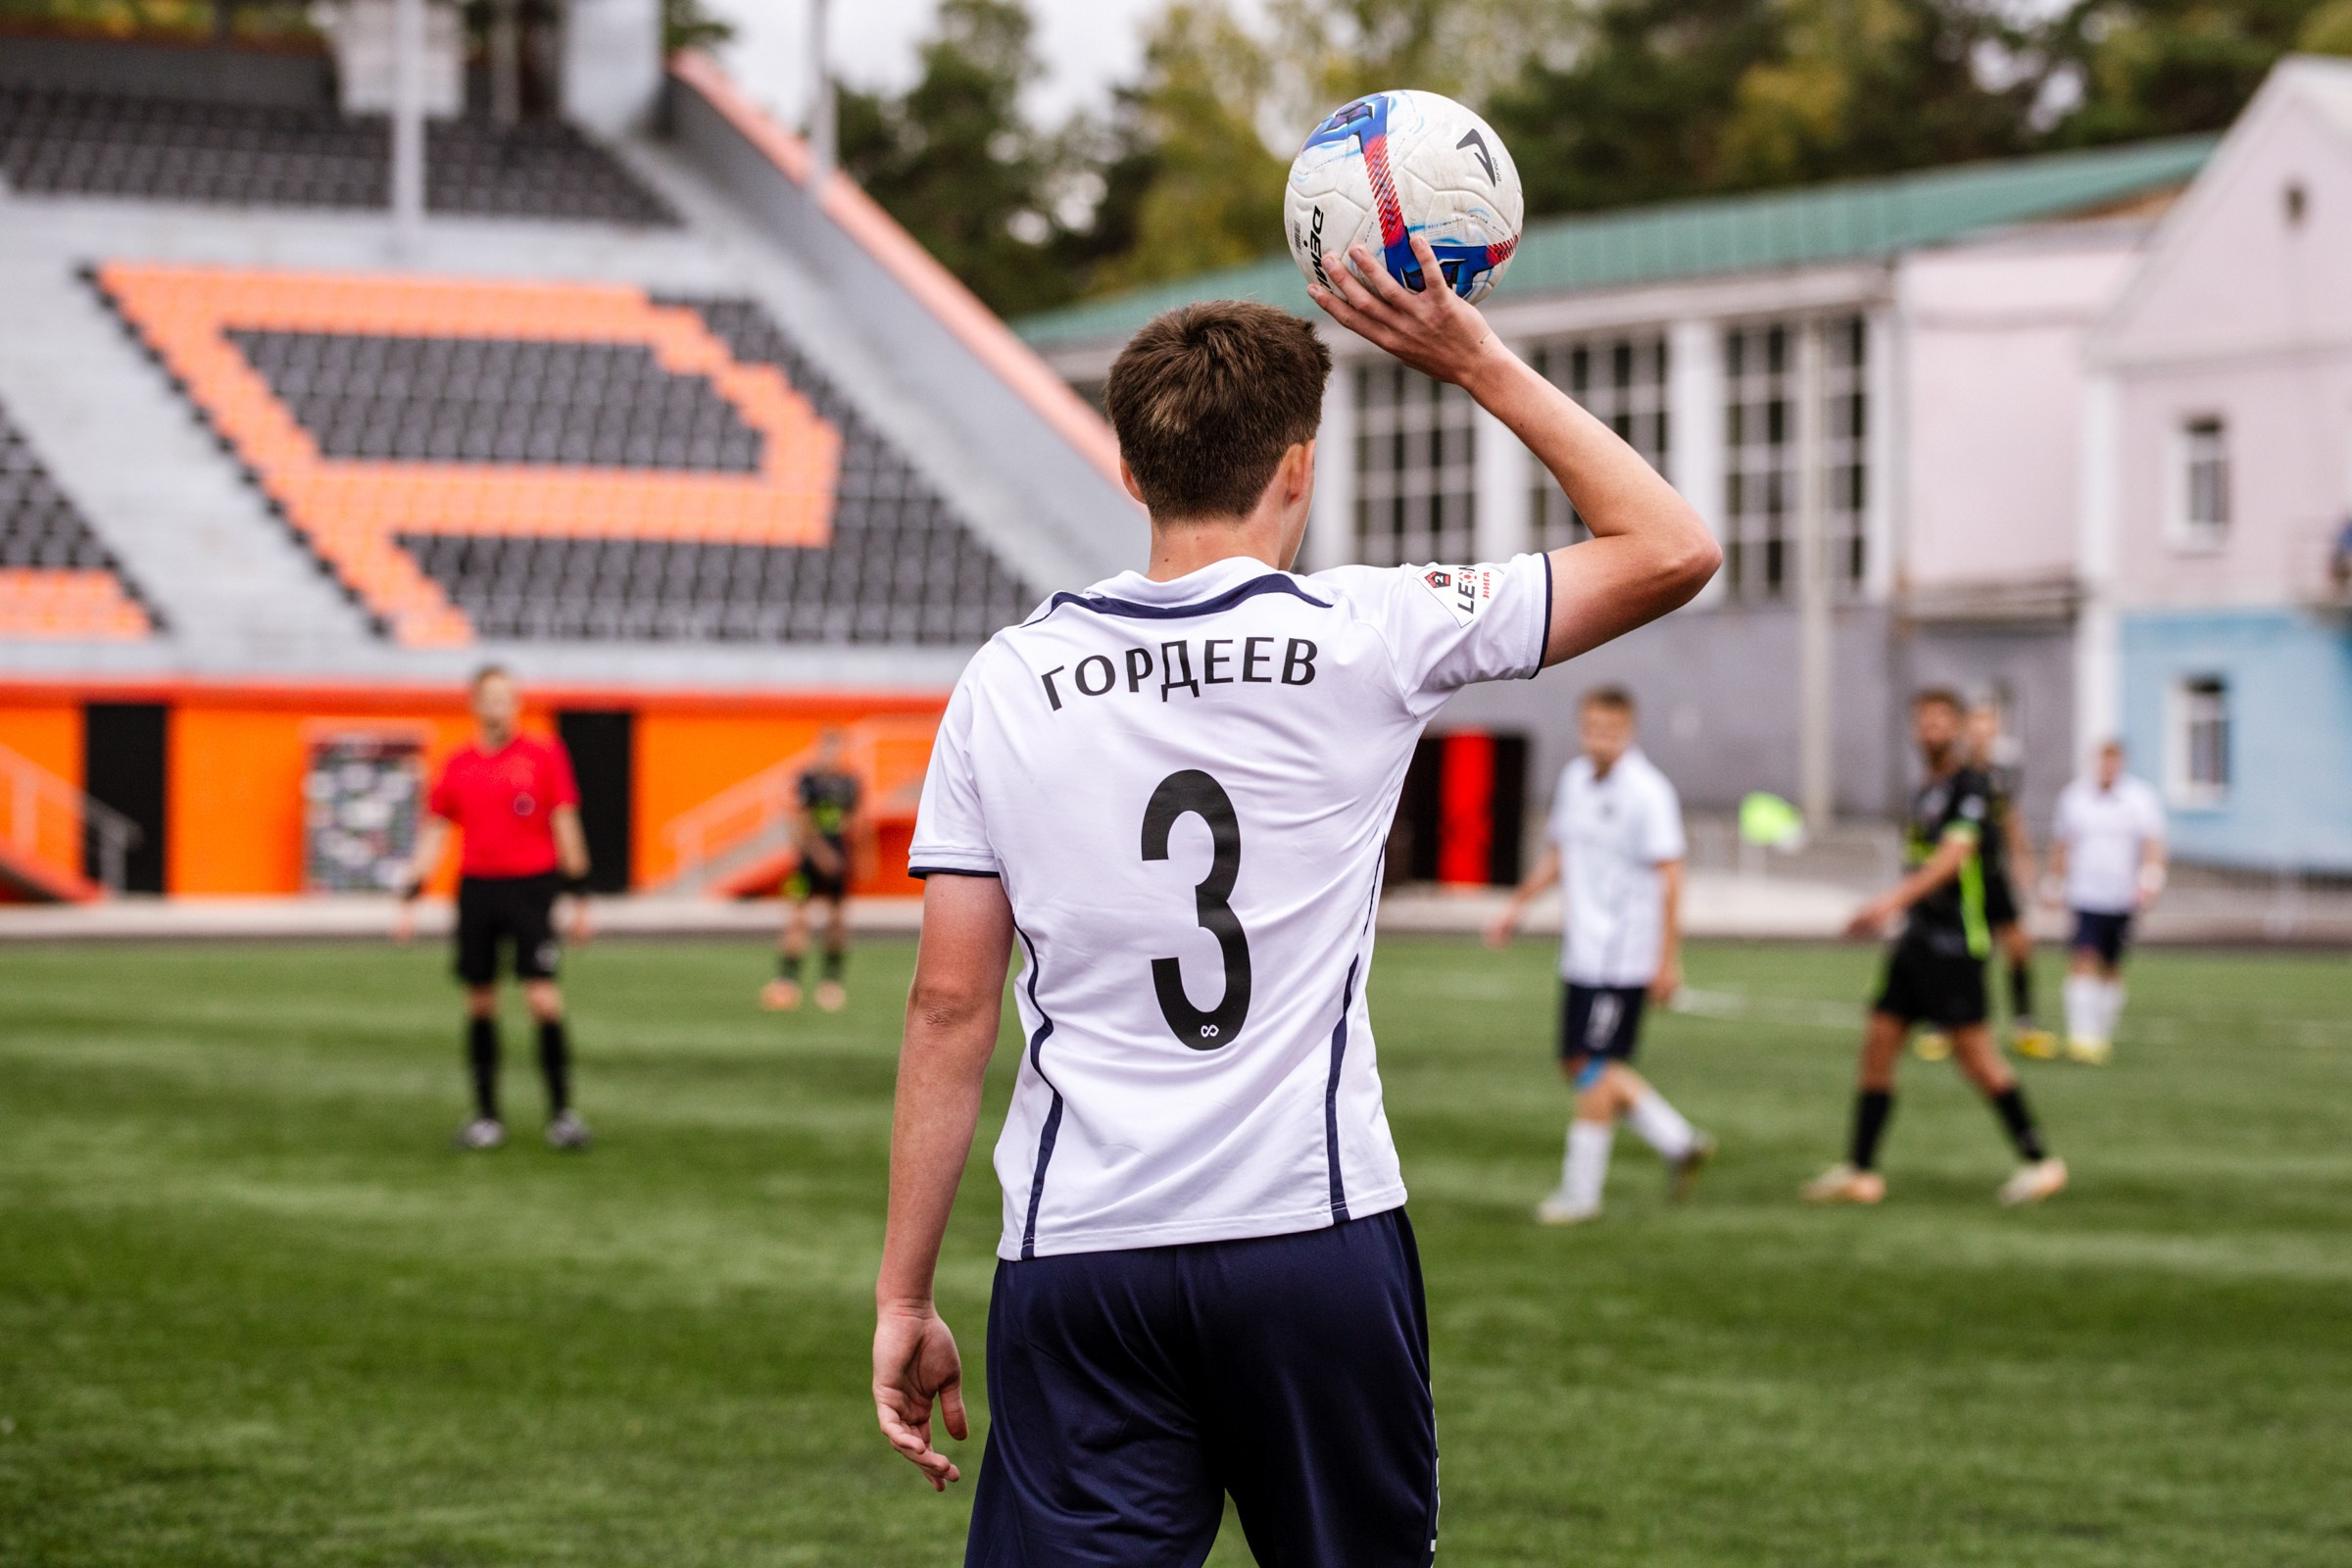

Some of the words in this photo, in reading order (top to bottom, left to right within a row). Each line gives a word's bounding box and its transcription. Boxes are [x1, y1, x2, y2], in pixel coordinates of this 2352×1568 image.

[1310, 205, 1334, 294] DEMI
[1041, 636, 1318, 711] ГОРДЕЕВ
[1141, 769, 1251, 1051] 3
